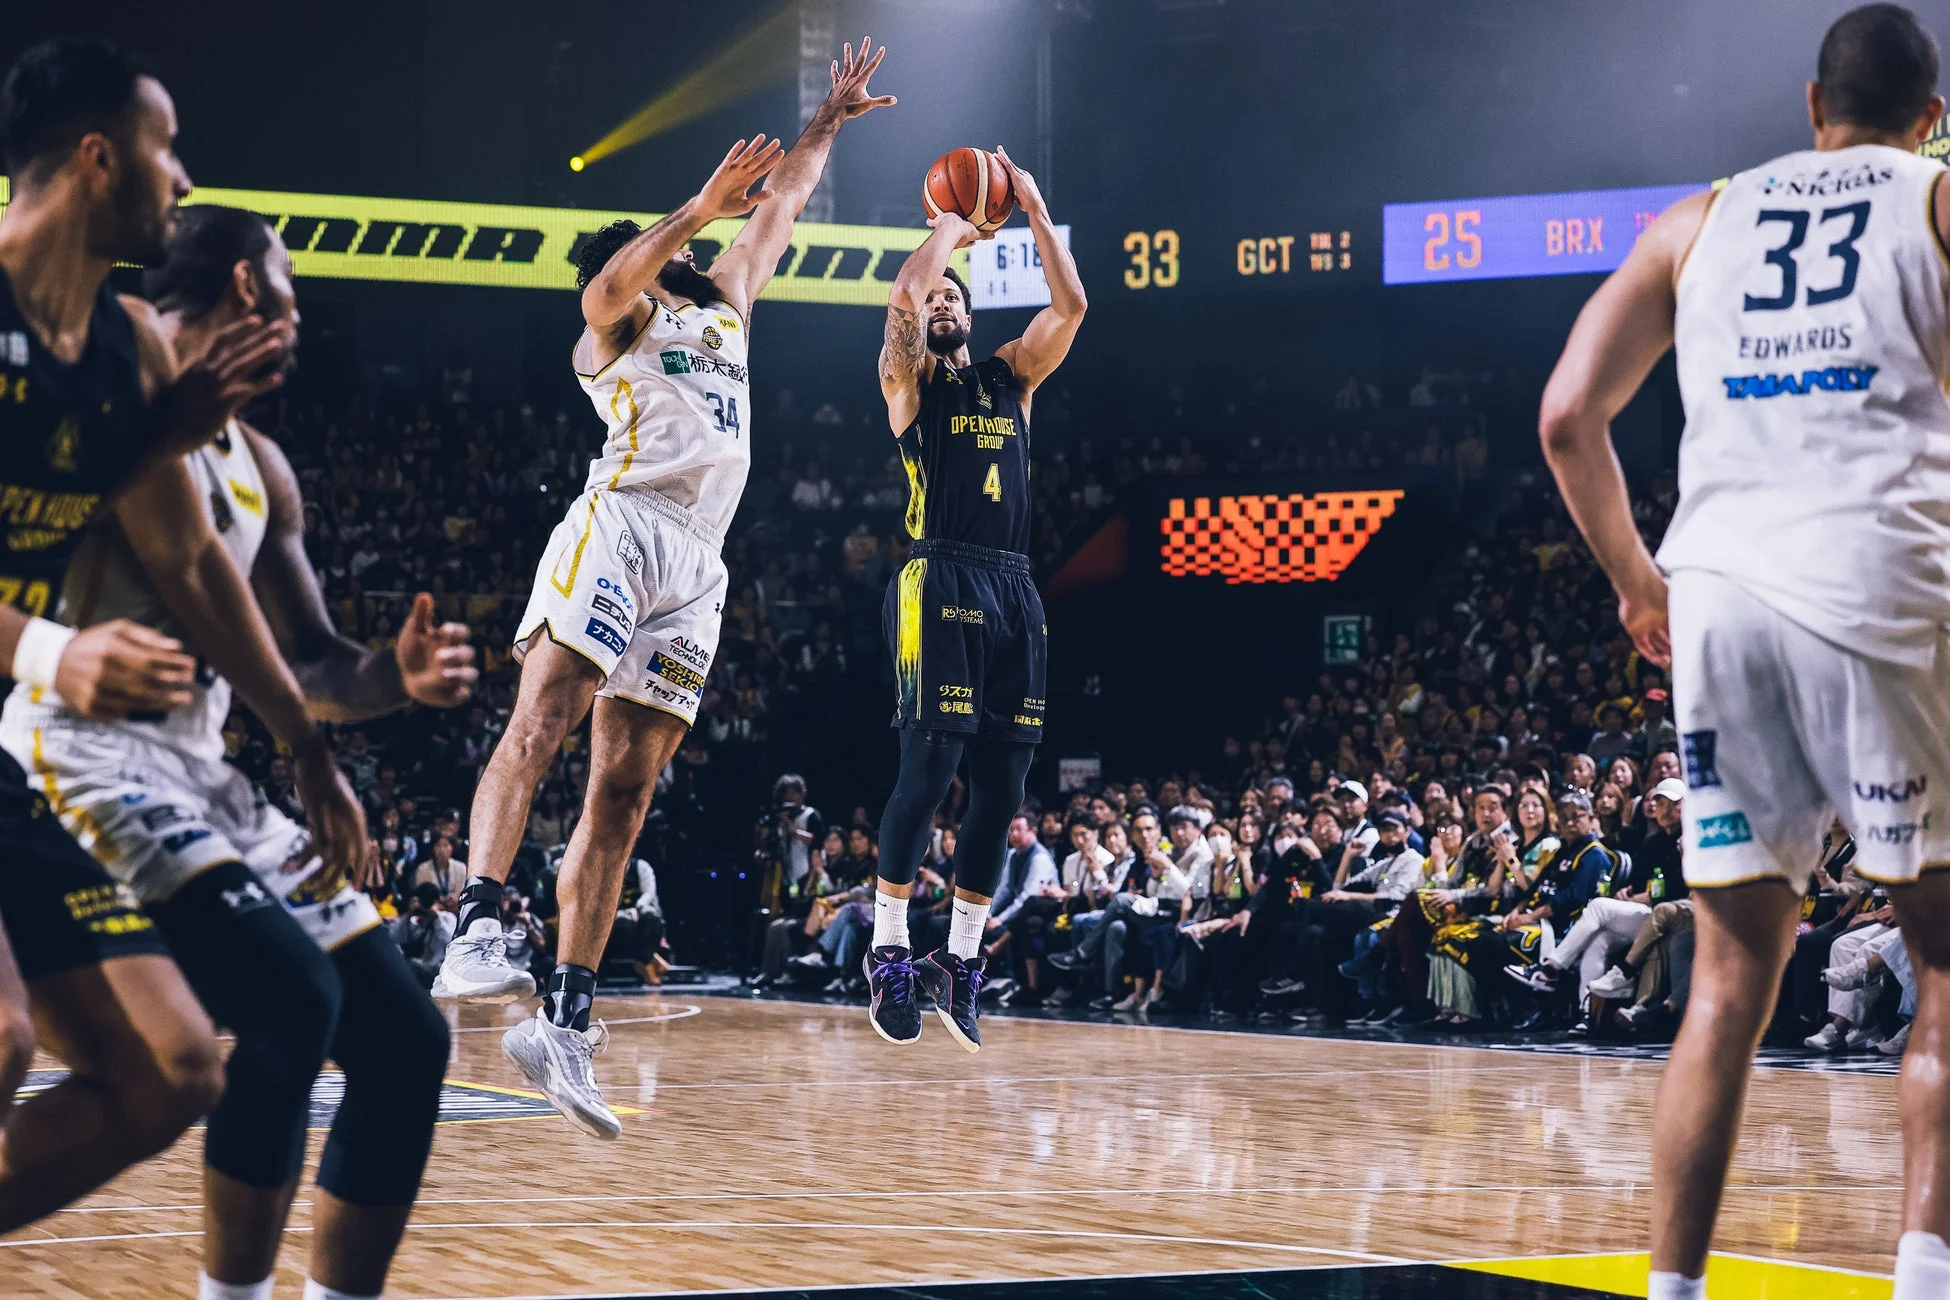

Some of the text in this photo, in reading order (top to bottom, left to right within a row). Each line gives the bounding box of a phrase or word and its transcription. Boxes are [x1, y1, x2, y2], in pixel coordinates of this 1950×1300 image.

[262, 214, 545, 263] NMA
[1237, 236, 1295, 275] GCT
[1424, 211, 1482, 270] 25
[1545, 217, 1604, 256] BRX
[1743, 200, 1872, 312] 33
[1124, 229, 1180, 289] 33
[1739, 324, 1853, 359] EDWARDS
[706, 392, 740, 439] 34
[977, 434, 1004, 450] GROUP
[983, 462, 1002, 502] 4
[959, 615, 984, 625] YSTEMS
[670, 635, 710, 664] ALME
